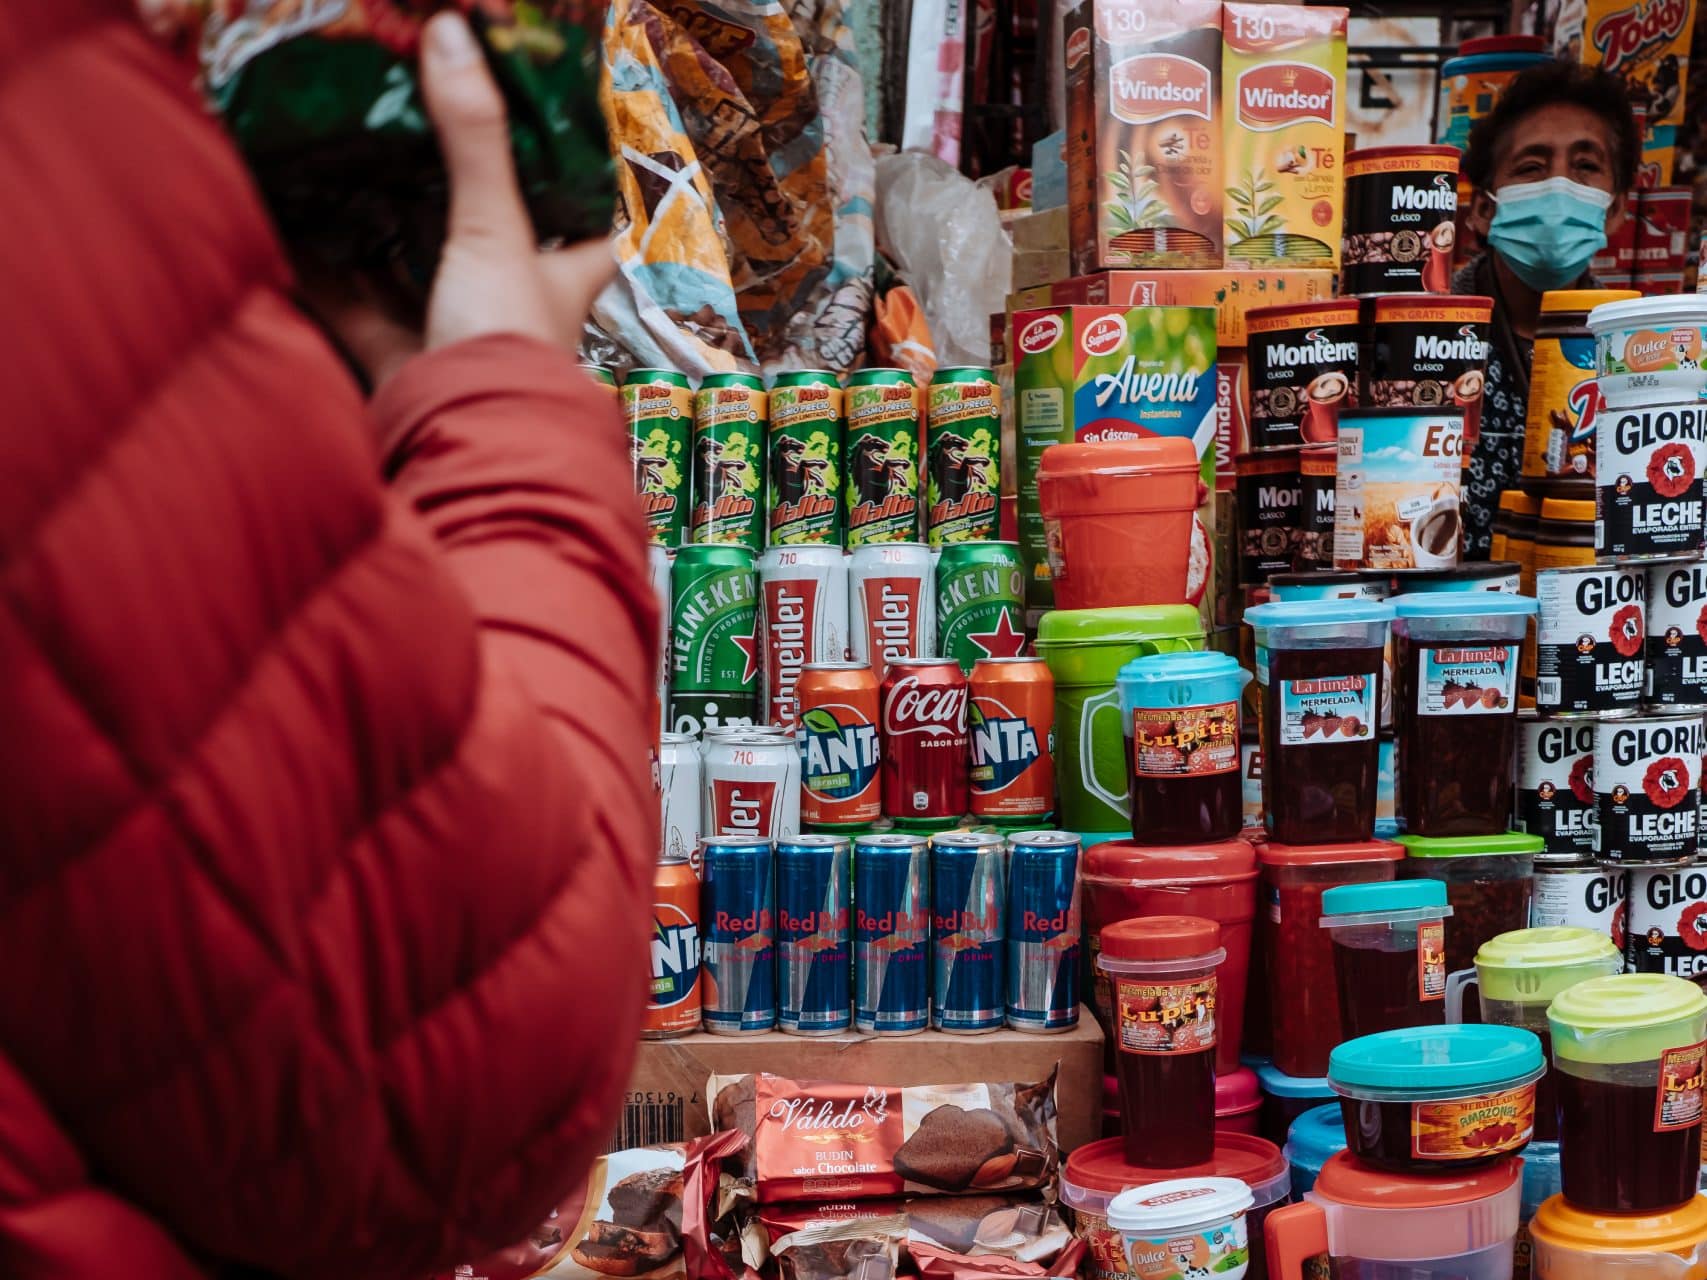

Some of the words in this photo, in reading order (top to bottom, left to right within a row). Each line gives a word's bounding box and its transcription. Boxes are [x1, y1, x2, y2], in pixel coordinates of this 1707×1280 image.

[1102, 9, 1146, 32] 130
[1232, 15, 1276, 40] 130
[1119, 77, 1204, 102] Windsor
[1244, 87, 1330, 110] Windsor
[1311, 147, 1336, 169] Té
[1266, 341, 1358, 367] Monterre
[1632, 340, 1668, 357] Dulce
[1095, 355, 1199, 407] Avena
[1216, 371, 1231, 465] Windsor
[1084, 432, 1100, 443] Sin
[851, 495, 916, 528] Maltín
[931, 494, 996, 527] Maltín
[1632, 501, 1702, 528] LECHE
[1632, 525, 1679, 535] EVAPORADA
[779, 551, 798, 566] 710
[721, 670, 739, 679] EST.
[1442, 667, 1498, 676] MERMELADA
[1296, 680, 1312, 694] La
[1301, 696, 1356, 706] MERMELADA
[921, 740, 951, 749] SABOR
[1137, 721, 1234, 749] Lupita
[733, 749, 753, 765] 710
[1629, 810, 1697, 836] LECHE
[1629, 834, 1673, 842] EVAPORADA
[716, 911, 757, 932] Red
[780, 910, 815, 932] Red
[857, 909, 892, 932] Red
[961, 909, 999, 932] Bull
[1024, 910, 1065, 932] Red
[1120, 997, 1216, 1025] Lupita
[770, 1094, 866, 1134] Válido
[1460, 1105, 1517, 1128] AMAZONAS
[815, 1150, 854, 1162] BUDIN
[792, 1167, 816, 1176] sabor
[817, 1161, 878, 1175] Chocolate
[1136, 1250, 1166, 1265] Dulce
